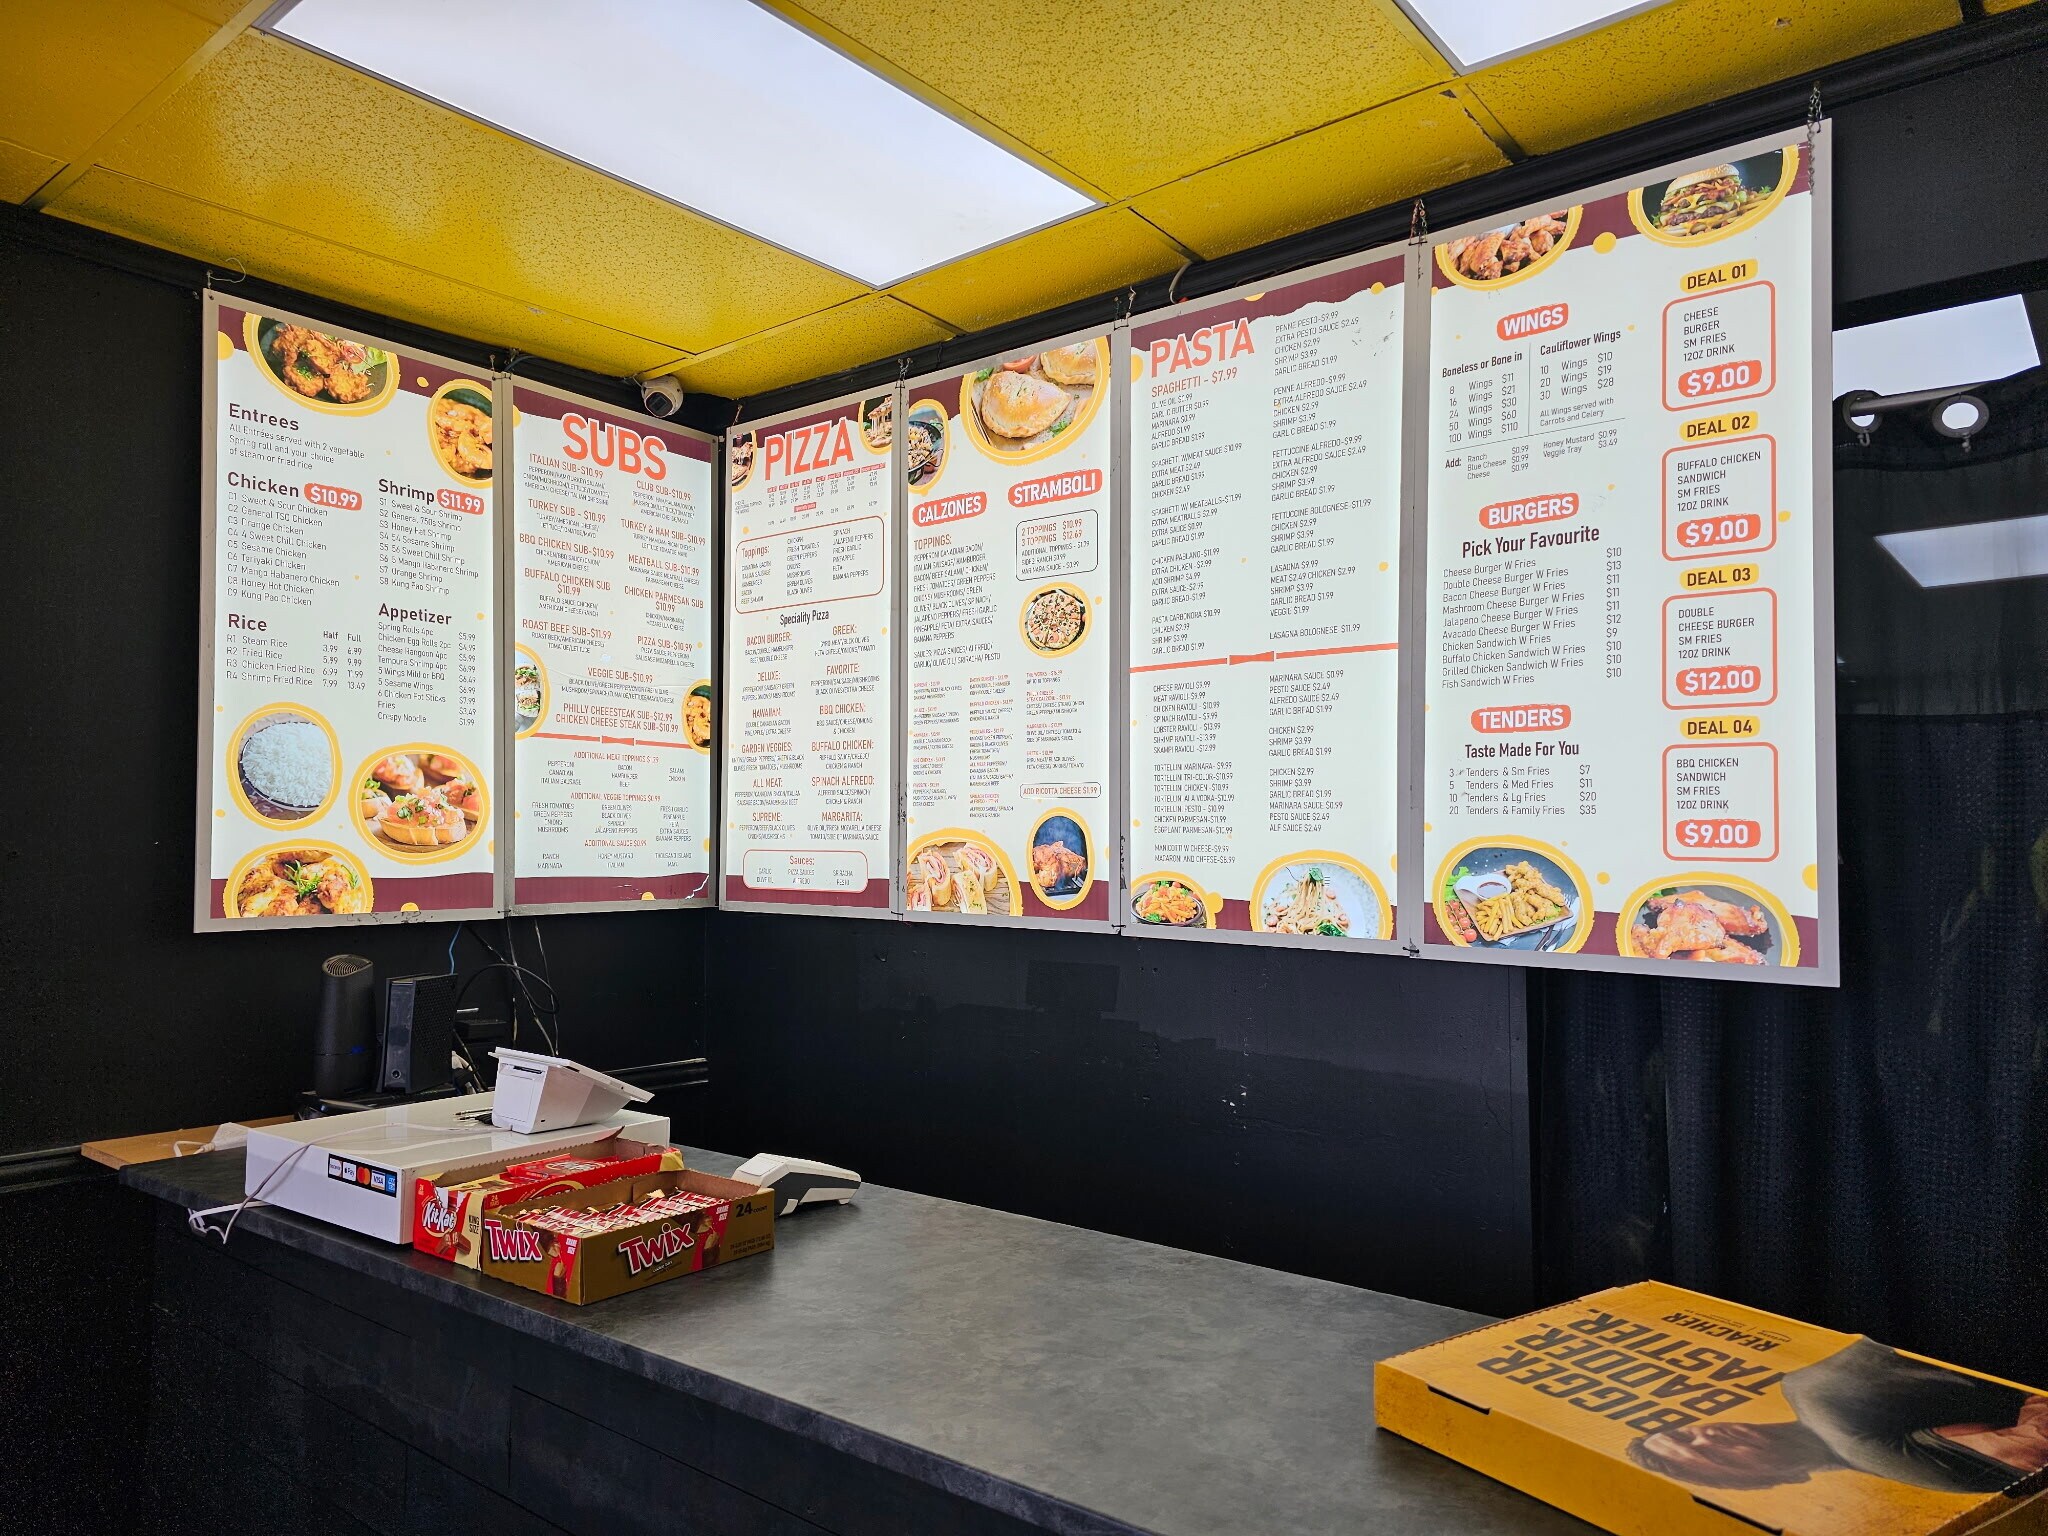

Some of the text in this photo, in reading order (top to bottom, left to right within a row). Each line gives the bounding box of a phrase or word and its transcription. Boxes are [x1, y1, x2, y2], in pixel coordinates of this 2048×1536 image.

[1688, 264, 1746, 289] DEAL 01
[1504, 307, 1563, 336] WINGS
[1684, 307, 1719, 322] CHEESE
[1684, 320, 1720, 335] BURGER
[1152, 318, 1254, 377] PASTA
[1274, 338, 1320, 355] CHICKEN $2.99
[1540, 330, 1621, 356] Cauliflower Wings
[1684, 332, 1727, 349] SM FRIES
[1707, 344, 1735, 357] DRINK
[1442, 352, 1522, 378] Boneless or Bone in
[1541, 352, 1613, 374] 10 Wings $10
[1152, 378, 1201, 397] SPAGHETTI
[1212, 368, 1238, 384] $7.99
[1450, 373, 1514, 394] 8 Wings $11
[1687, 365, 1749, 395] $9.00
[1274, 380, 1367, 406] EXTRA ALFREDO SAUCE $2.49
[1540, 378, 1613, 400] 30 Wings $28
[1551, 407, 1571, 416] Wings
[1573, 401, 1597, 412] served
[1599, 397, 1614, 406] with
[230, 403, 298, 430] Entrees
[1540, 409, 1604, 426] Carrots and Celery
[1449, 422, 1518, 443] 100 Wings $110
[1687, 416, 1750, 437] DEAL 02
[563, 415, 667, 480] SUBS
[765, 419, 854, 481] PIZZA
[529, 454, 560, 468] ITALIAN
[1445, 459, 1462, 468] Add:
[1678, 451, 1761, 471] BUFFALO CHICKEN
[1678, 470, 1726, 484] SANDWICH
[228, 472, 357, 508] Chicken $10.99
[379, 479, 480, 512] Shrimp $11.99
[1014, 473, 1096, 504] STRAMBOLI
[1678, 485, 1720, 498] SM FRIES
[918, 496, 981, 523] CALZONES
[1489, 497, 1574, 525] BURGERS
[1701, 497, 1728, 509] DRINK
[1027, 523, 1057, 535] TOPPINGS
[1063, 518, 1082, 530] $10.99
[1686, 519, 1748, 545] $9.00
[520, 534, 536, 544] BBQ
[539, 537, 571, 552] CHICKEN
[914, 534, 952, 550] TOPPINGS:
[1027, 534, 1057, 546] TOPPINGS
[1463, 526, 1600, 558] Pick Your Favourite
[742, 544, 770, 559] Toppings:
[524, 568, 611, 590] BUFFALO CHICKEN SUB
[1688, 568, 1750, 586] DEAL 03
[558, 585, 580, 596] $10.99
[379, 603, 451, 625] Appetizer
[780, 610, 829, 627] Speciality Pizza
[1679, 607, 1714, 618] DOUBLE
[228, 614, 267, 631] Rice
[833, 624, 857, 635] GREEK:
[1679, 618, 1755, 631] CHEESE BURGER
[323, 631, 361, 642] Half Full
[1443, 628, 1617, 652] Chicken Sandwich W Fries $9
[1679, 634, 1722, 645] SM FRIES
[226, 647, 282, 659] R2 Fried Rice
[1702, 647, 1730, 657] DRINK
[827, 663, 860, 675] FAVORITE:
[1685, 670, 1753, 692] $12.00
[1269, 692, 1339, 704] ALFREDO SAUCE $2.49
[1479, 708, 1563, 729] TENDERS
[1688, 720, 1752, 735] DEAL 04
[1465, 741, 1579, 758] Taste Made For You
[1677, 758, 1738, 768] BBQ CHICKEN
[1677, 772, 1726, 781] SANDWICH
[1023, 787, 1034, 795] ADD
[1035, 787, 1058, 795] RICOTTA
[1677, 786, 1720, 795] SM FRIES
[1449, 805, 1597, 817] 20 Tenders & Family Fries $35
[1701, 800, 1729, 809] DRINK
[822, 811, 863, 822] MARGARITA:
[1685, 823, 1748, 845] $9.00
[374, 1176, 383, 1184] VISA
[469, 1215, 479, 1225] KING
[469, 1224, 479, 1234] SIZE
[1661, 1312, 1784, 1352] REACHER
[1567, 1309, 1787, 1396] TASTIER.
[1515, 1322, 1753, 1416] BADDER.
[1476, 1344, 1702, 1436] BIGGER.
